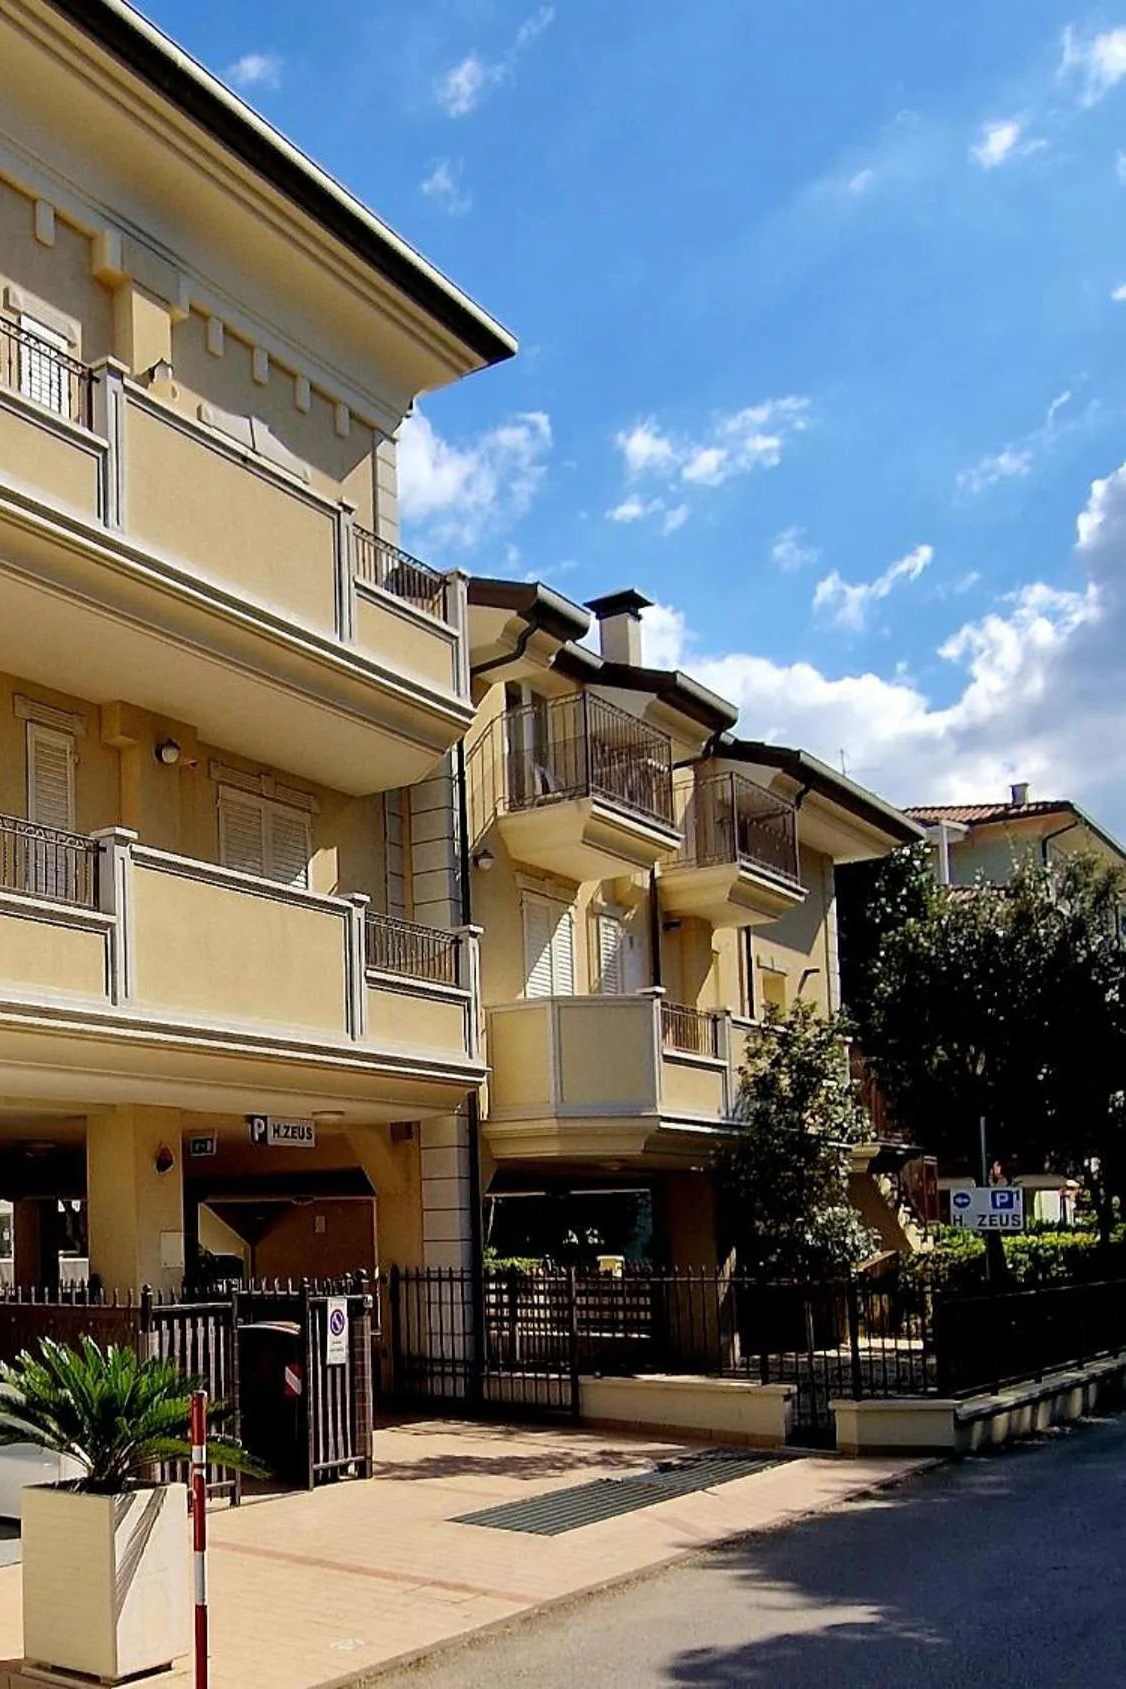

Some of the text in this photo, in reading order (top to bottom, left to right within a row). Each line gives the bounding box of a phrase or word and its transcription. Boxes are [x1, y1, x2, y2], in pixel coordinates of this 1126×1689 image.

[253, 1117, 313, 1142] P H.ZEUS
[995, 1192, 1010, 1208] P
[976, 1213, 1022, 1228] ZEUS
